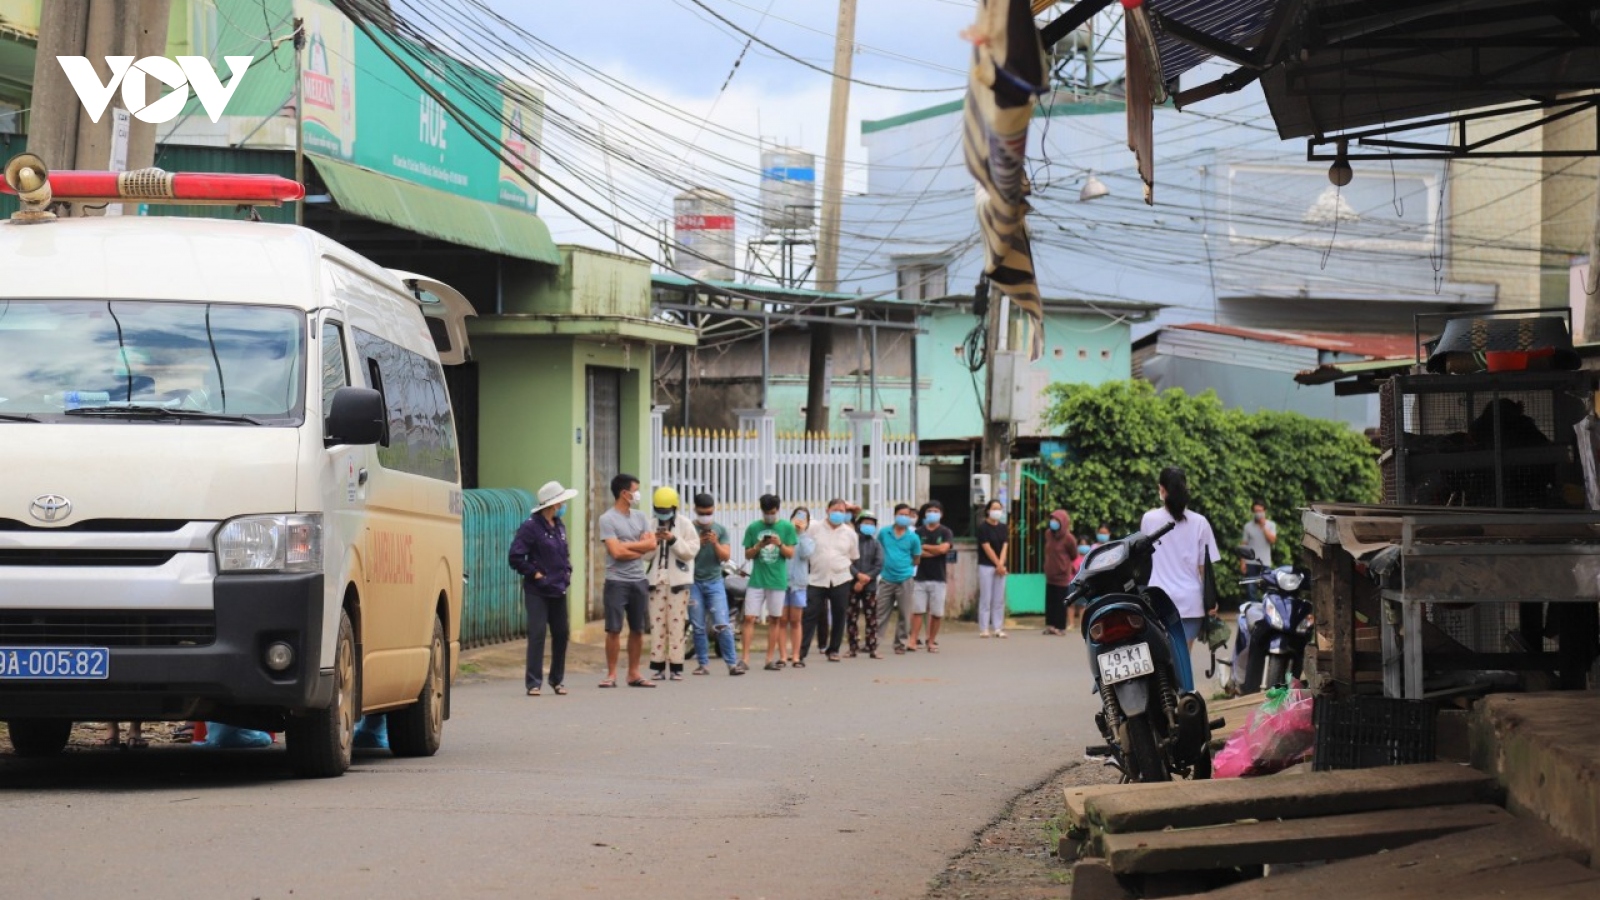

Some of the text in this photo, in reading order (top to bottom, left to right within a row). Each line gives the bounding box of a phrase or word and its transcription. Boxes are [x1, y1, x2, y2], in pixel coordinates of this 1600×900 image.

[373, 531, 414, 584] AMBULANCE
[1107, 647, 1142, 666] 49-K1
[1104, 660, 1151, 681] 543.86
